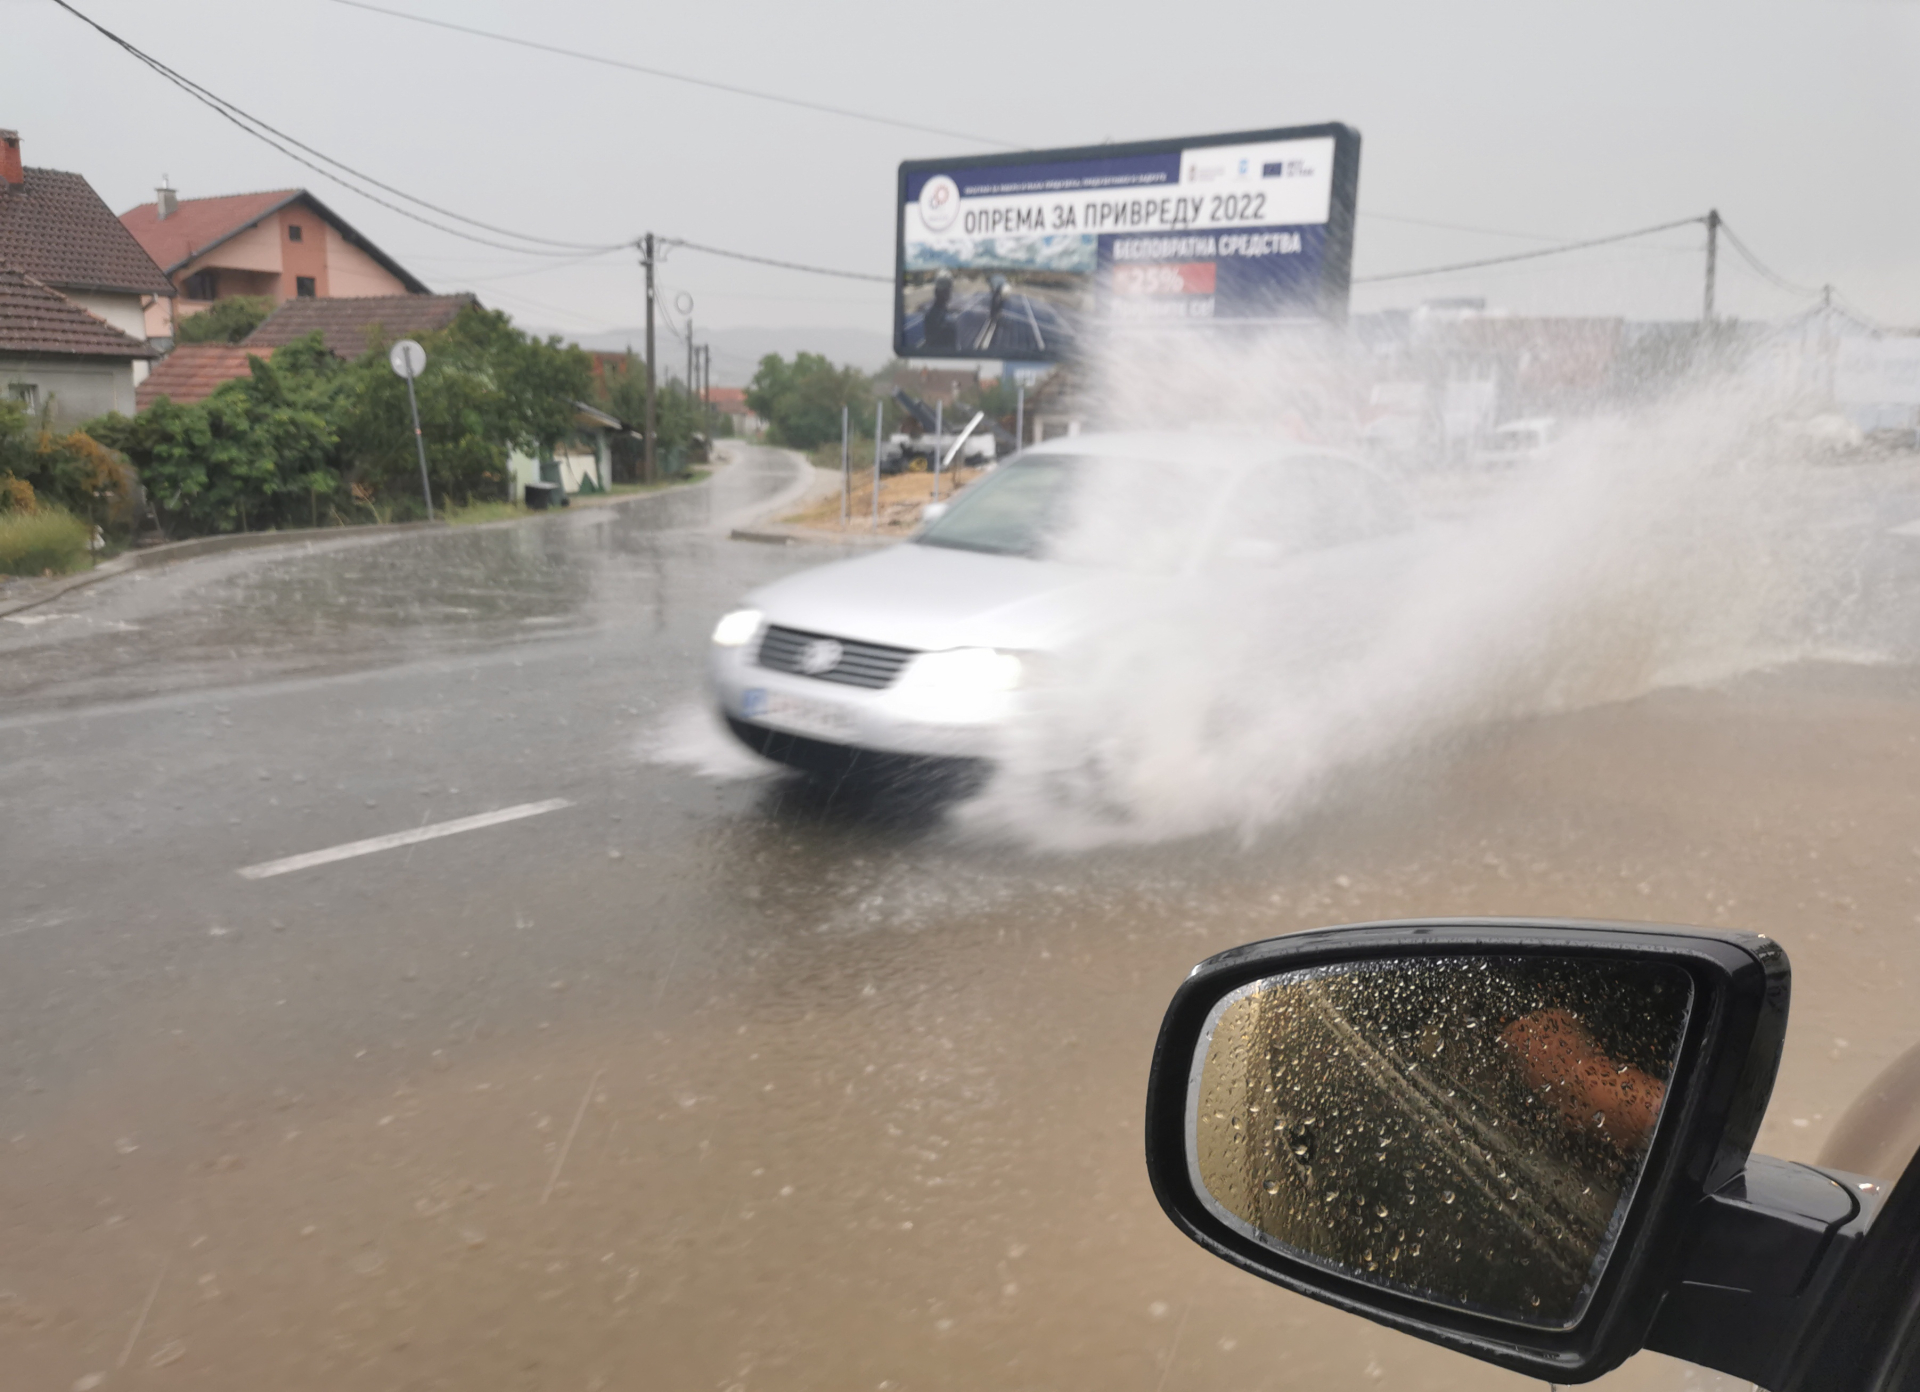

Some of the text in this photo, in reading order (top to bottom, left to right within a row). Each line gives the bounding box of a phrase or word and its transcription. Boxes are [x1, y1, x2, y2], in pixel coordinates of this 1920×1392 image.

[964, 192, 1267, 234] ОПРЕМА ЗА ПРИВРЕДУ 2022
[1113, 231, 1303, 260] БЕСПОВРАТНА СРЕДСТВА
